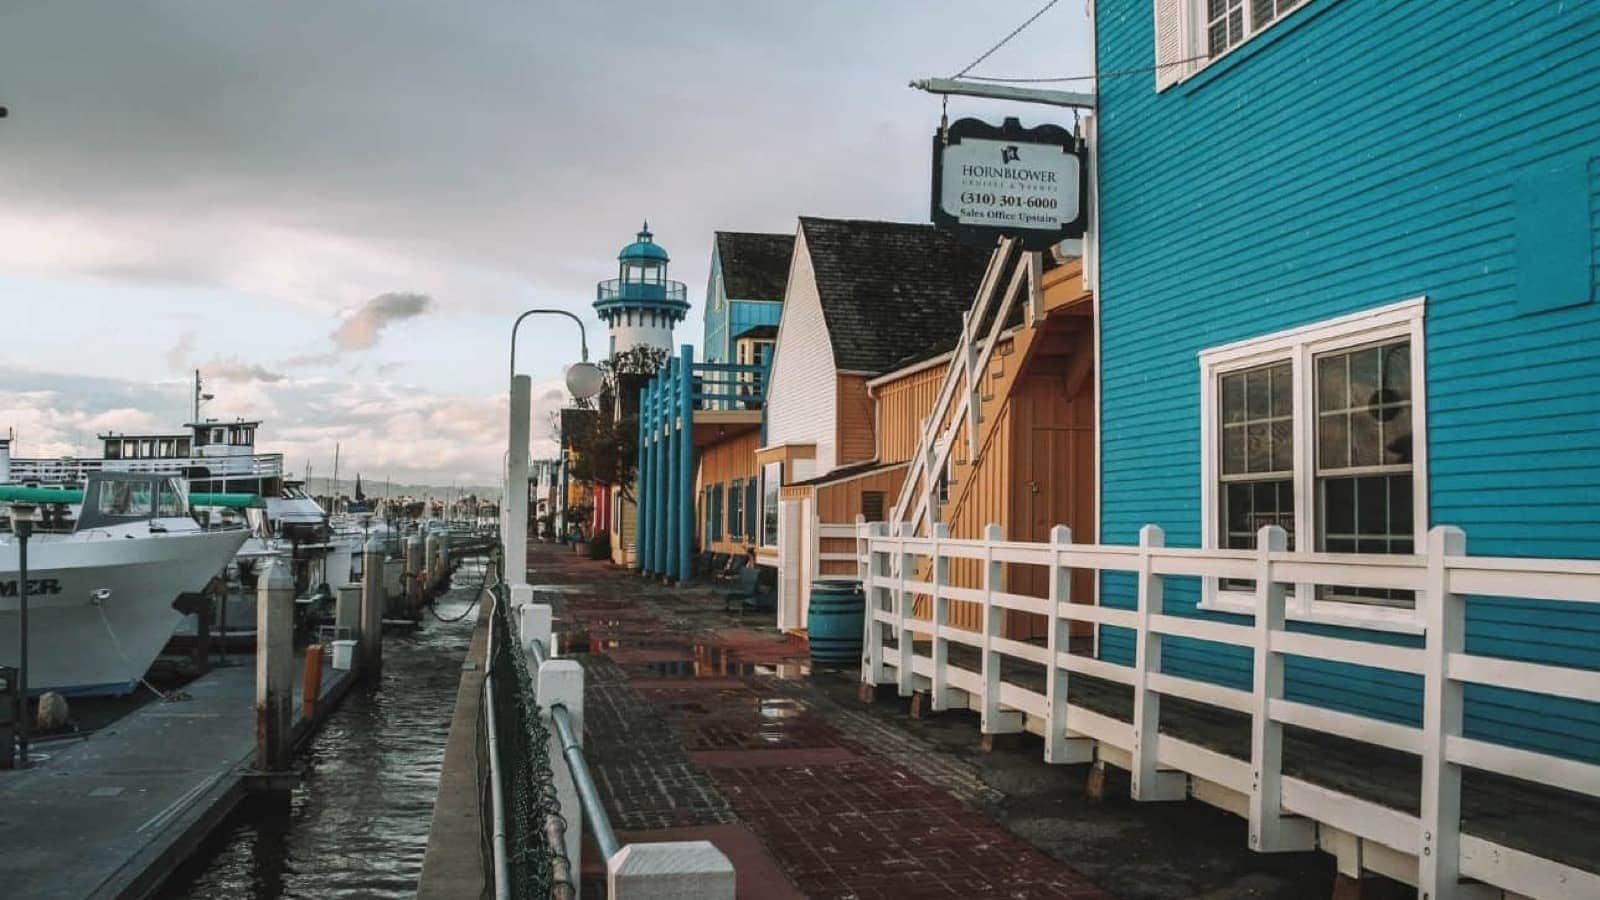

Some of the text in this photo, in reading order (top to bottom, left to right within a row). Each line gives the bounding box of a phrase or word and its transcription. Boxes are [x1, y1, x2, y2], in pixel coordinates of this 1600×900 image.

[962, 164, 1057, 183] HORNBLOWER
[961, 191, 1058, 210] (310) 301-6000
[960, 208, 1058, 224] Sales Office Upstairs
